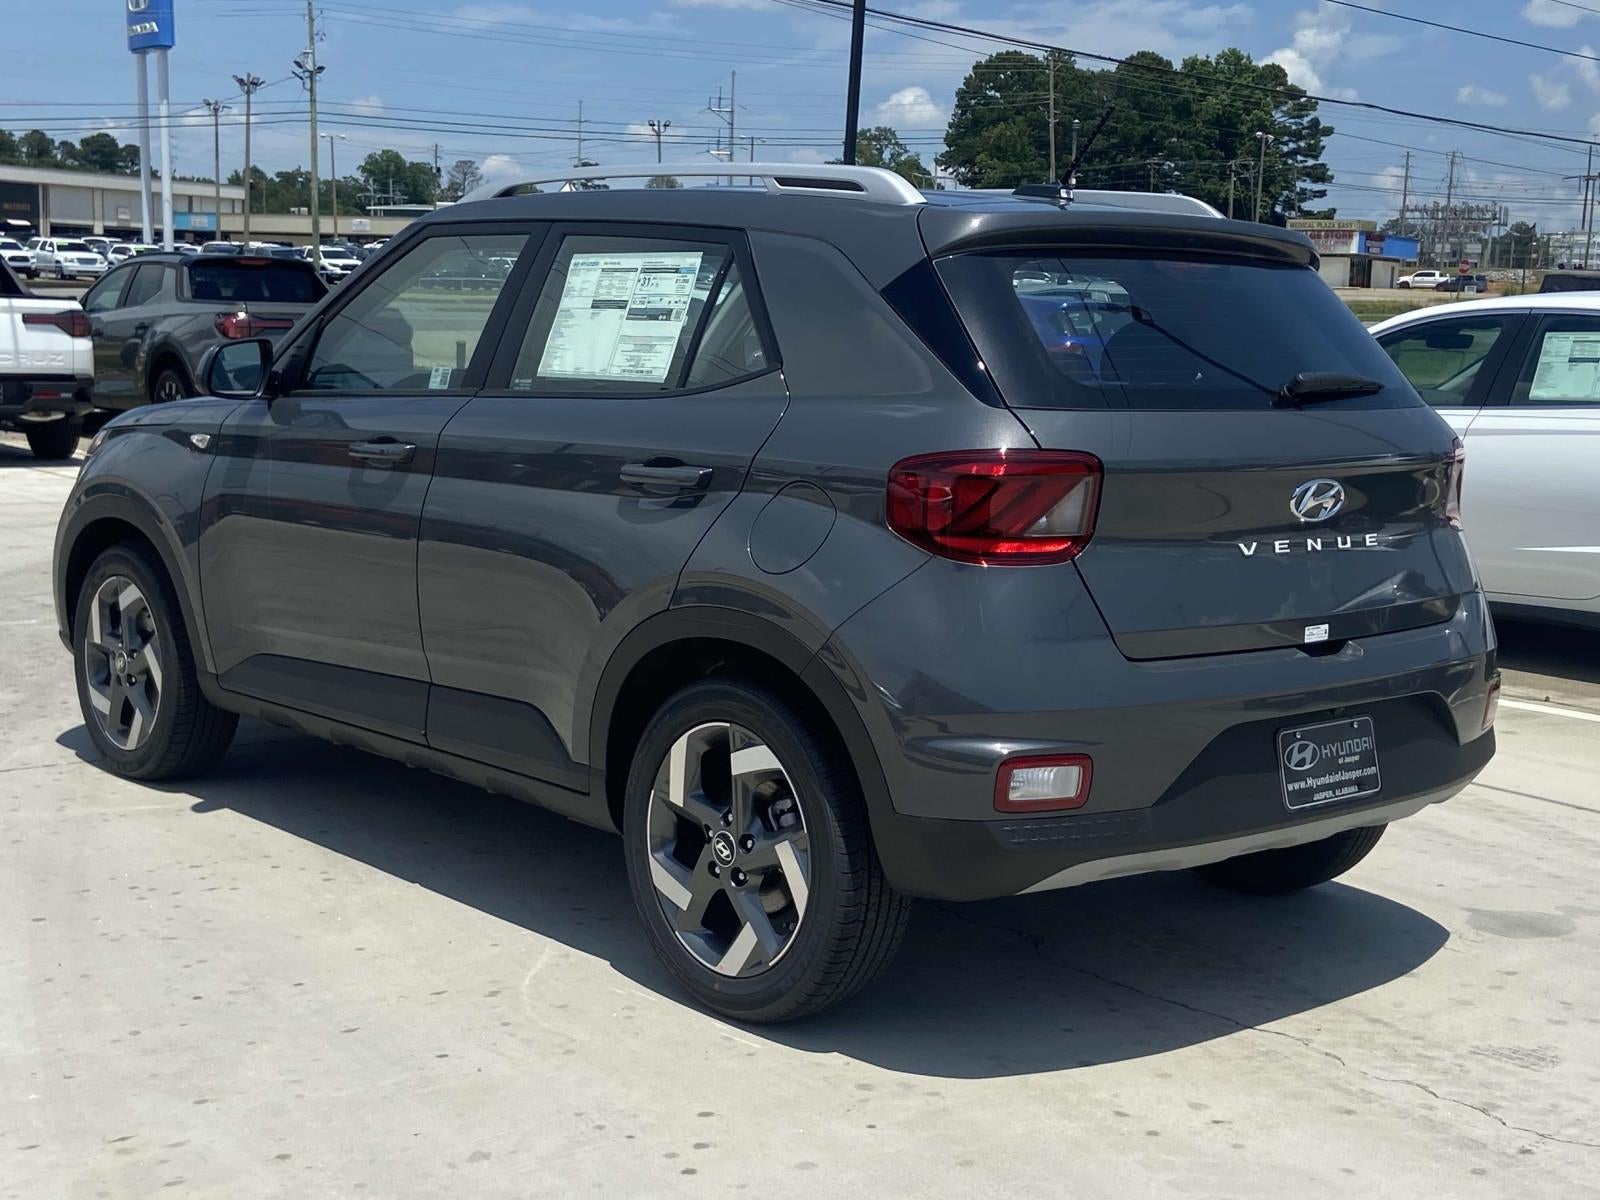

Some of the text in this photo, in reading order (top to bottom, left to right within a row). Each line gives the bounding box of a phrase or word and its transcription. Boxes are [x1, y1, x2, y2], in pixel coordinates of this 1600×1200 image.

[1323, 231, 1354, 240] STORE
[1238, 533, 1378, 556] VENUE
[1322, 737, 1373, 758] HYUNDAI
[1287, 766, 1377, 791] www.HyundaiofJasper.com
[1335, 785, 1359, 796] ALABAMA
